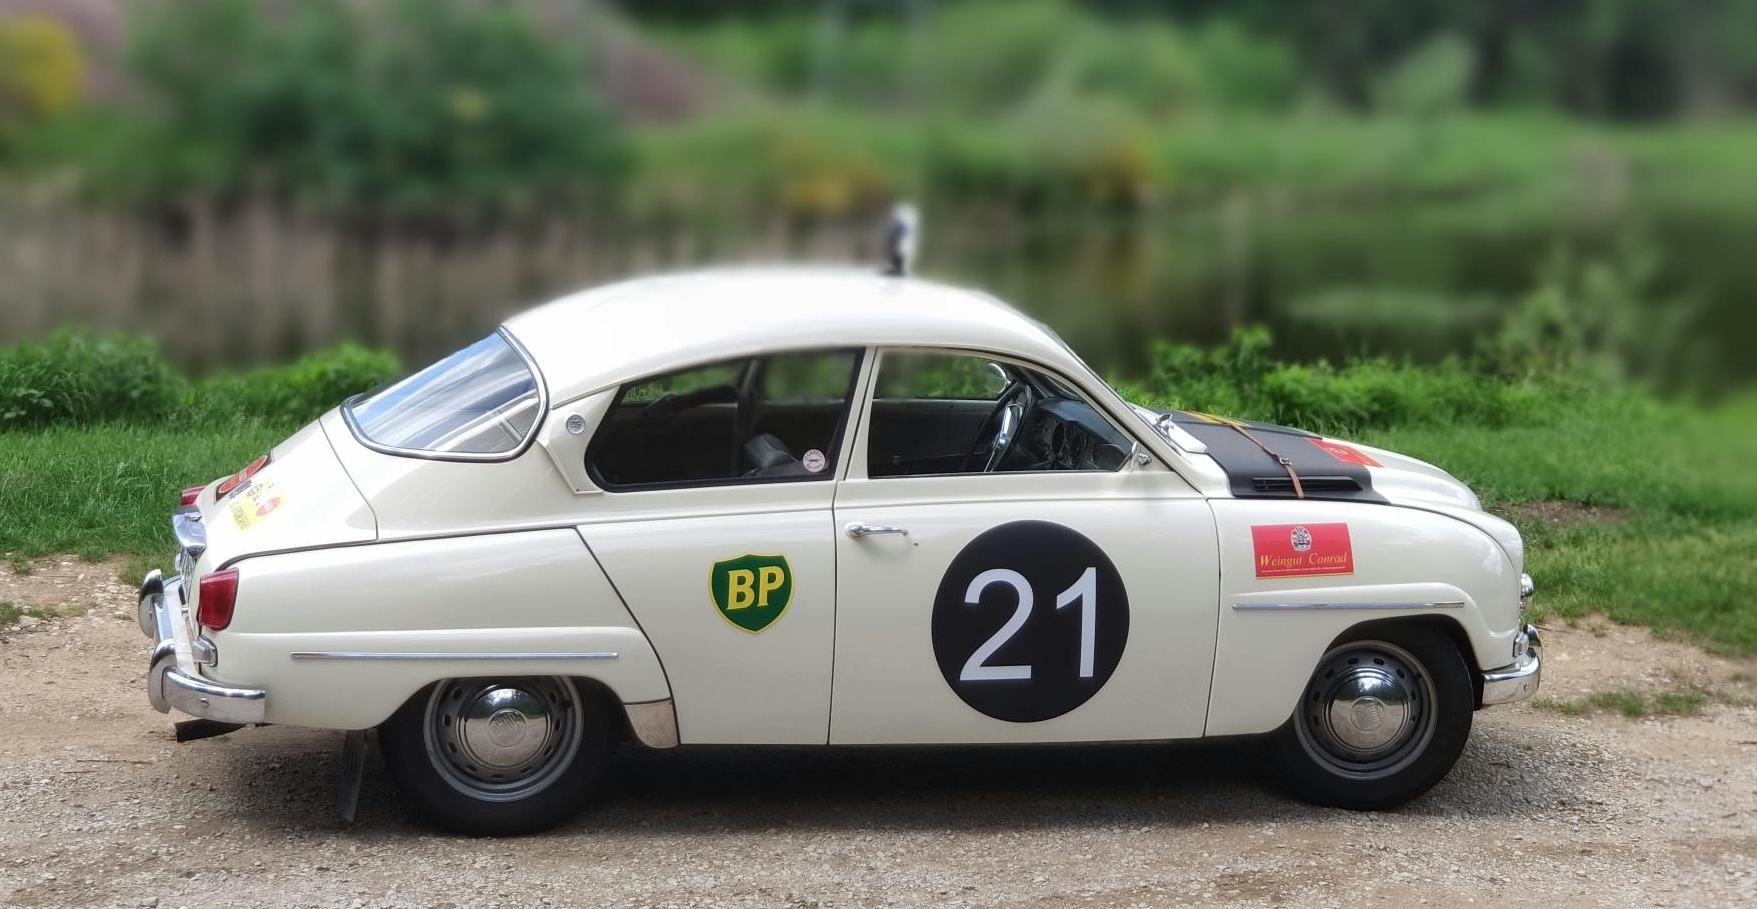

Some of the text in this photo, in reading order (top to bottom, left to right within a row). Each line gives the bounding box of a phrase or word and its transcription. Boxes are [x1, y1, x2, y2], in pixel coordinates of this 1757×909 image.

[1260, 551, 1347, 568] Weingut Conrad
[726, 565, 785, 610] BP
[959, 566, 1098, 681] 21
